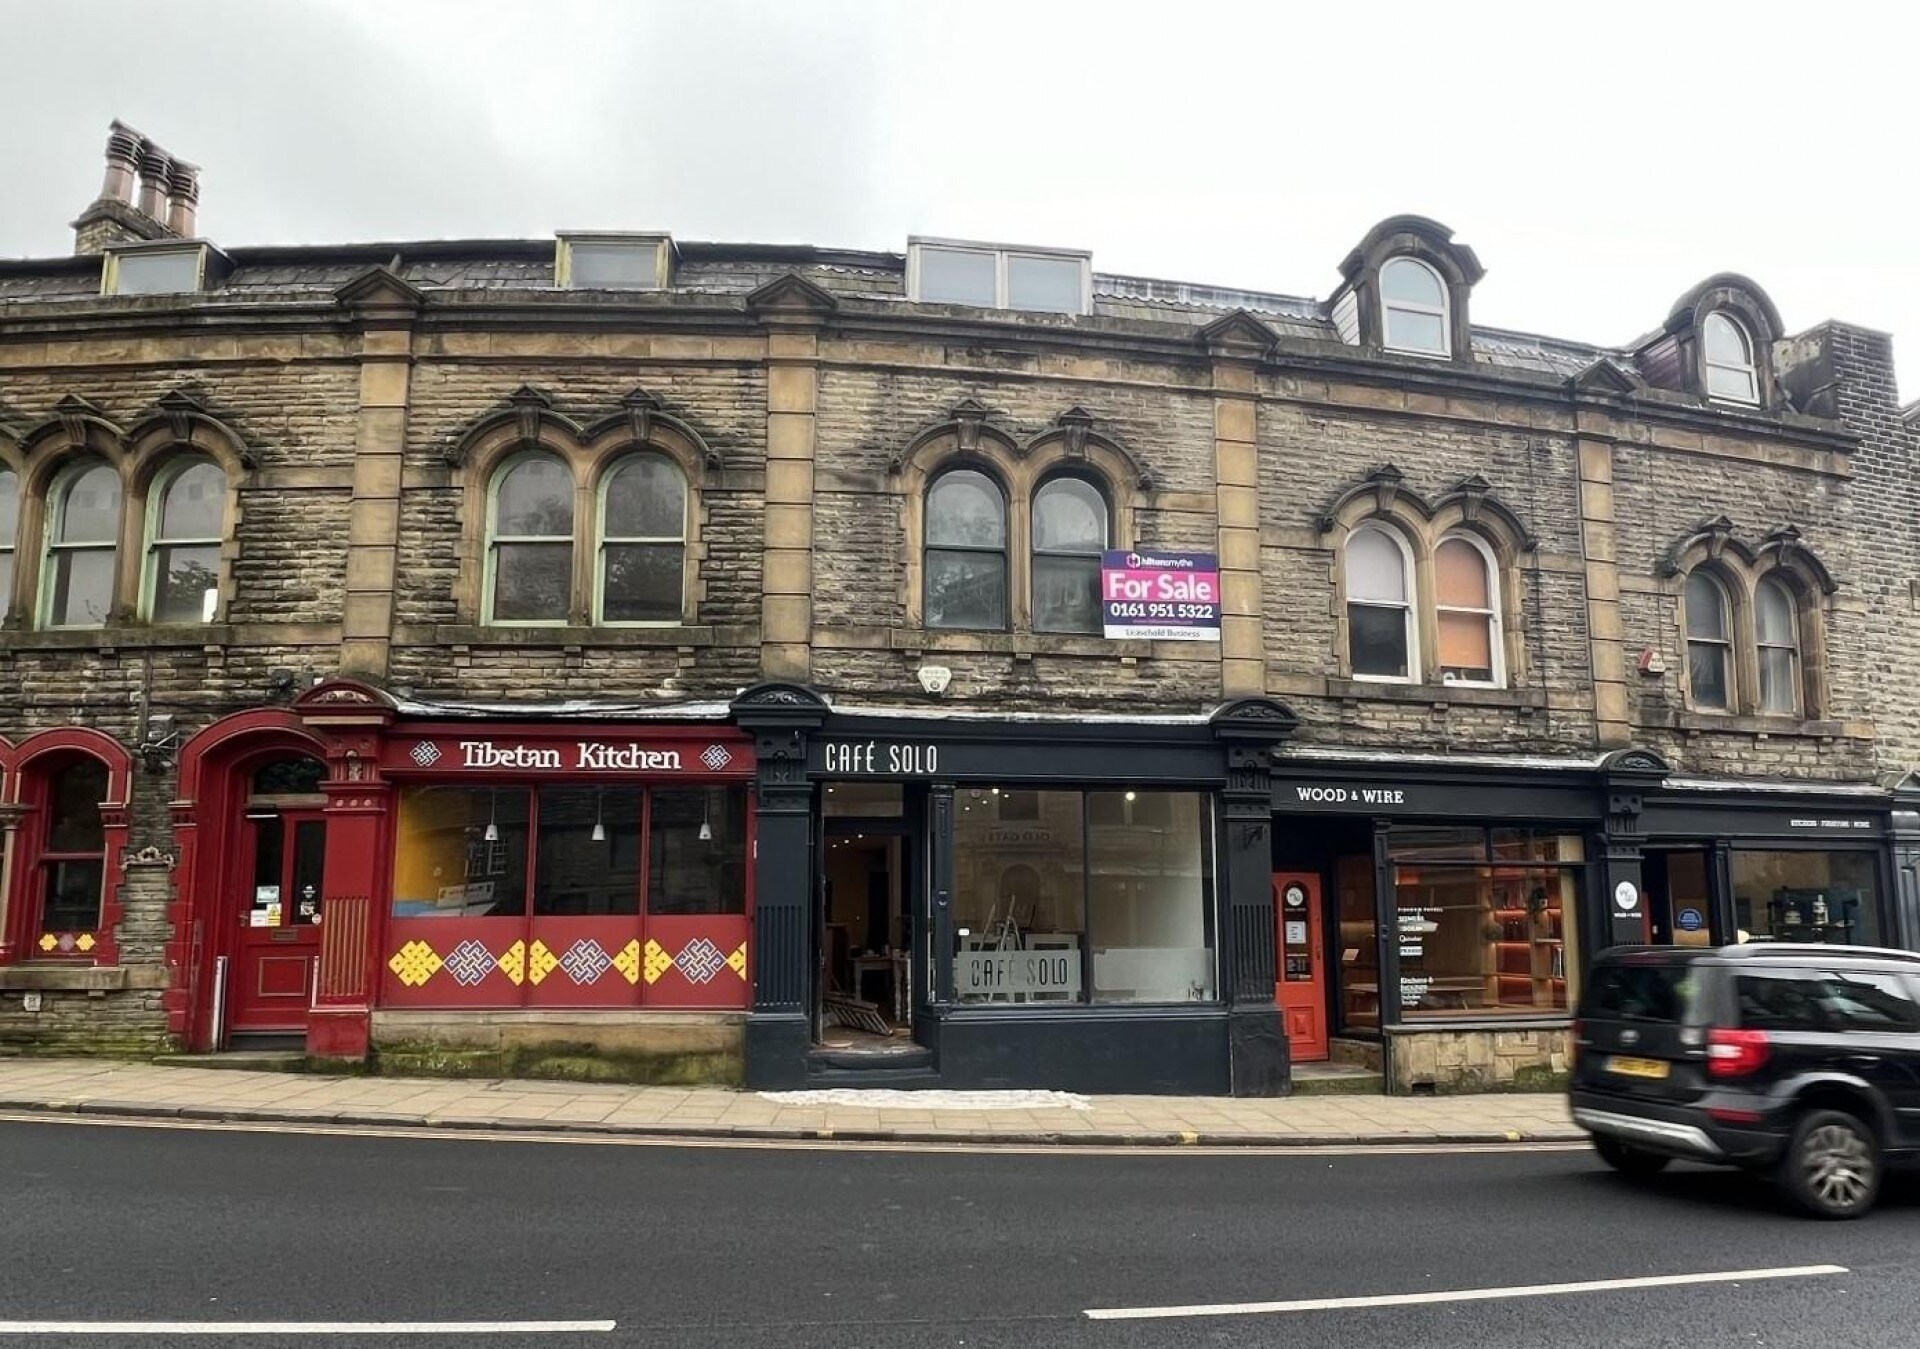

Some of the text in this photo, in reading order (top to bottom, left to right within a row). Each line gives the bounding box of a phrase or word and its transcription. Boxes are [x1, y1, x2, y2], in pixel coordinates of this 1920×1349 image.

[1109, 572, 1212, 601] For Sale
[1110, 602, 1213, 619] 0161 951 5322
[1167, 629, 1201, 638] Business
[460, 741, 682, 769] Tibetan Kitchen
[826, 741, 938, 773] CAFÉ SOLO
[1296, 787, 1405, 804] WOOD & WIRE
[1027, 958, 1068, 986] SOLO
